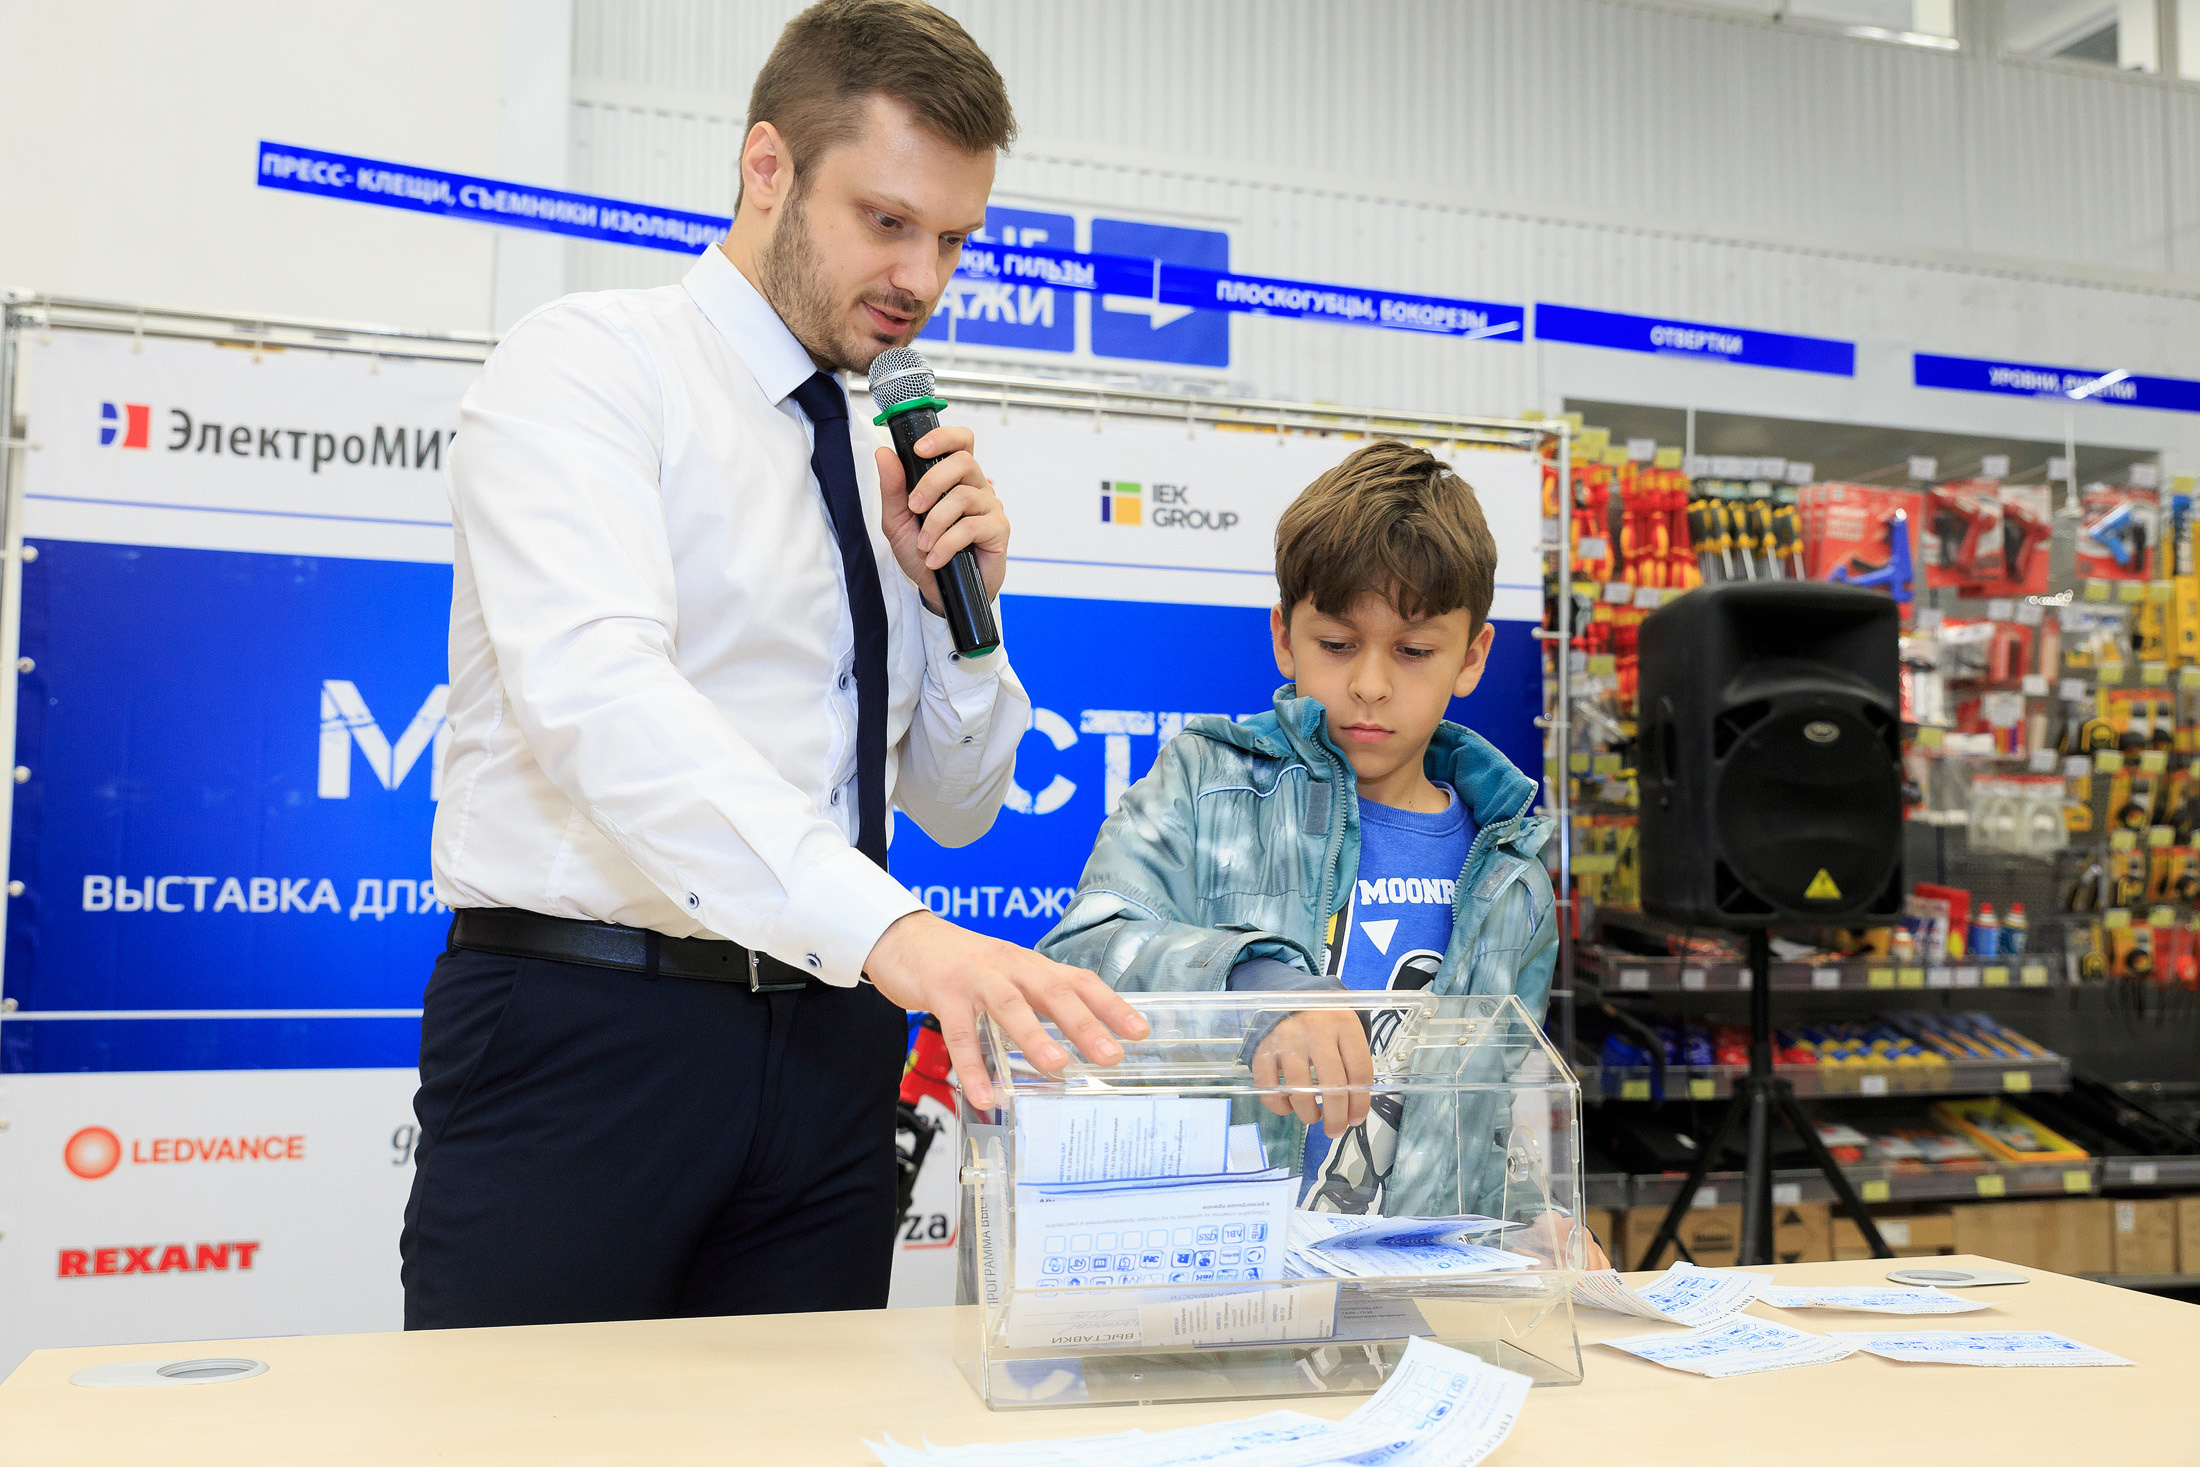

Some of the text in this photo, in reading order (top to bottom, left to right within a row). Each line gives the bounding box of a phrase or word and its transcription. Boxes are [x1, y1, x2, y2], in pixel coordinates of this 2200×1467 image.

[262, 152, 355, 188] ПРЕСС-
[356, 166, 457, 208] КЛЕЩИ,
[459, 184, 599, 228] СЪЕМНИКИ
[1003, 253, 1095, 287] ГИЛЬЗЫ
[930, 282, 1056, 329] АЖИ
[1216, 279, 1488, 330] ПЛОСКОГУБЦЫ, БОКОРЕЗЫ
[1650, 325, 1744, 356] ОТВЕРТКИ
[168, 408, 458, 474] ЭлектроМИ
[1152, 483, 1188, 506] IEK
[1152, 507, 1239, 533] GROUP
[82, 874, 1077, 921] ВЫСТАВКА ДЛЯ ОНТАЖ
[1358, 877, 1457, 905] MOONR
[131, 1135, 307, 1165] LEDVANCE
[904, 1213, 948, 1242] za
[57, 1240, 262, 1279] REXANT
